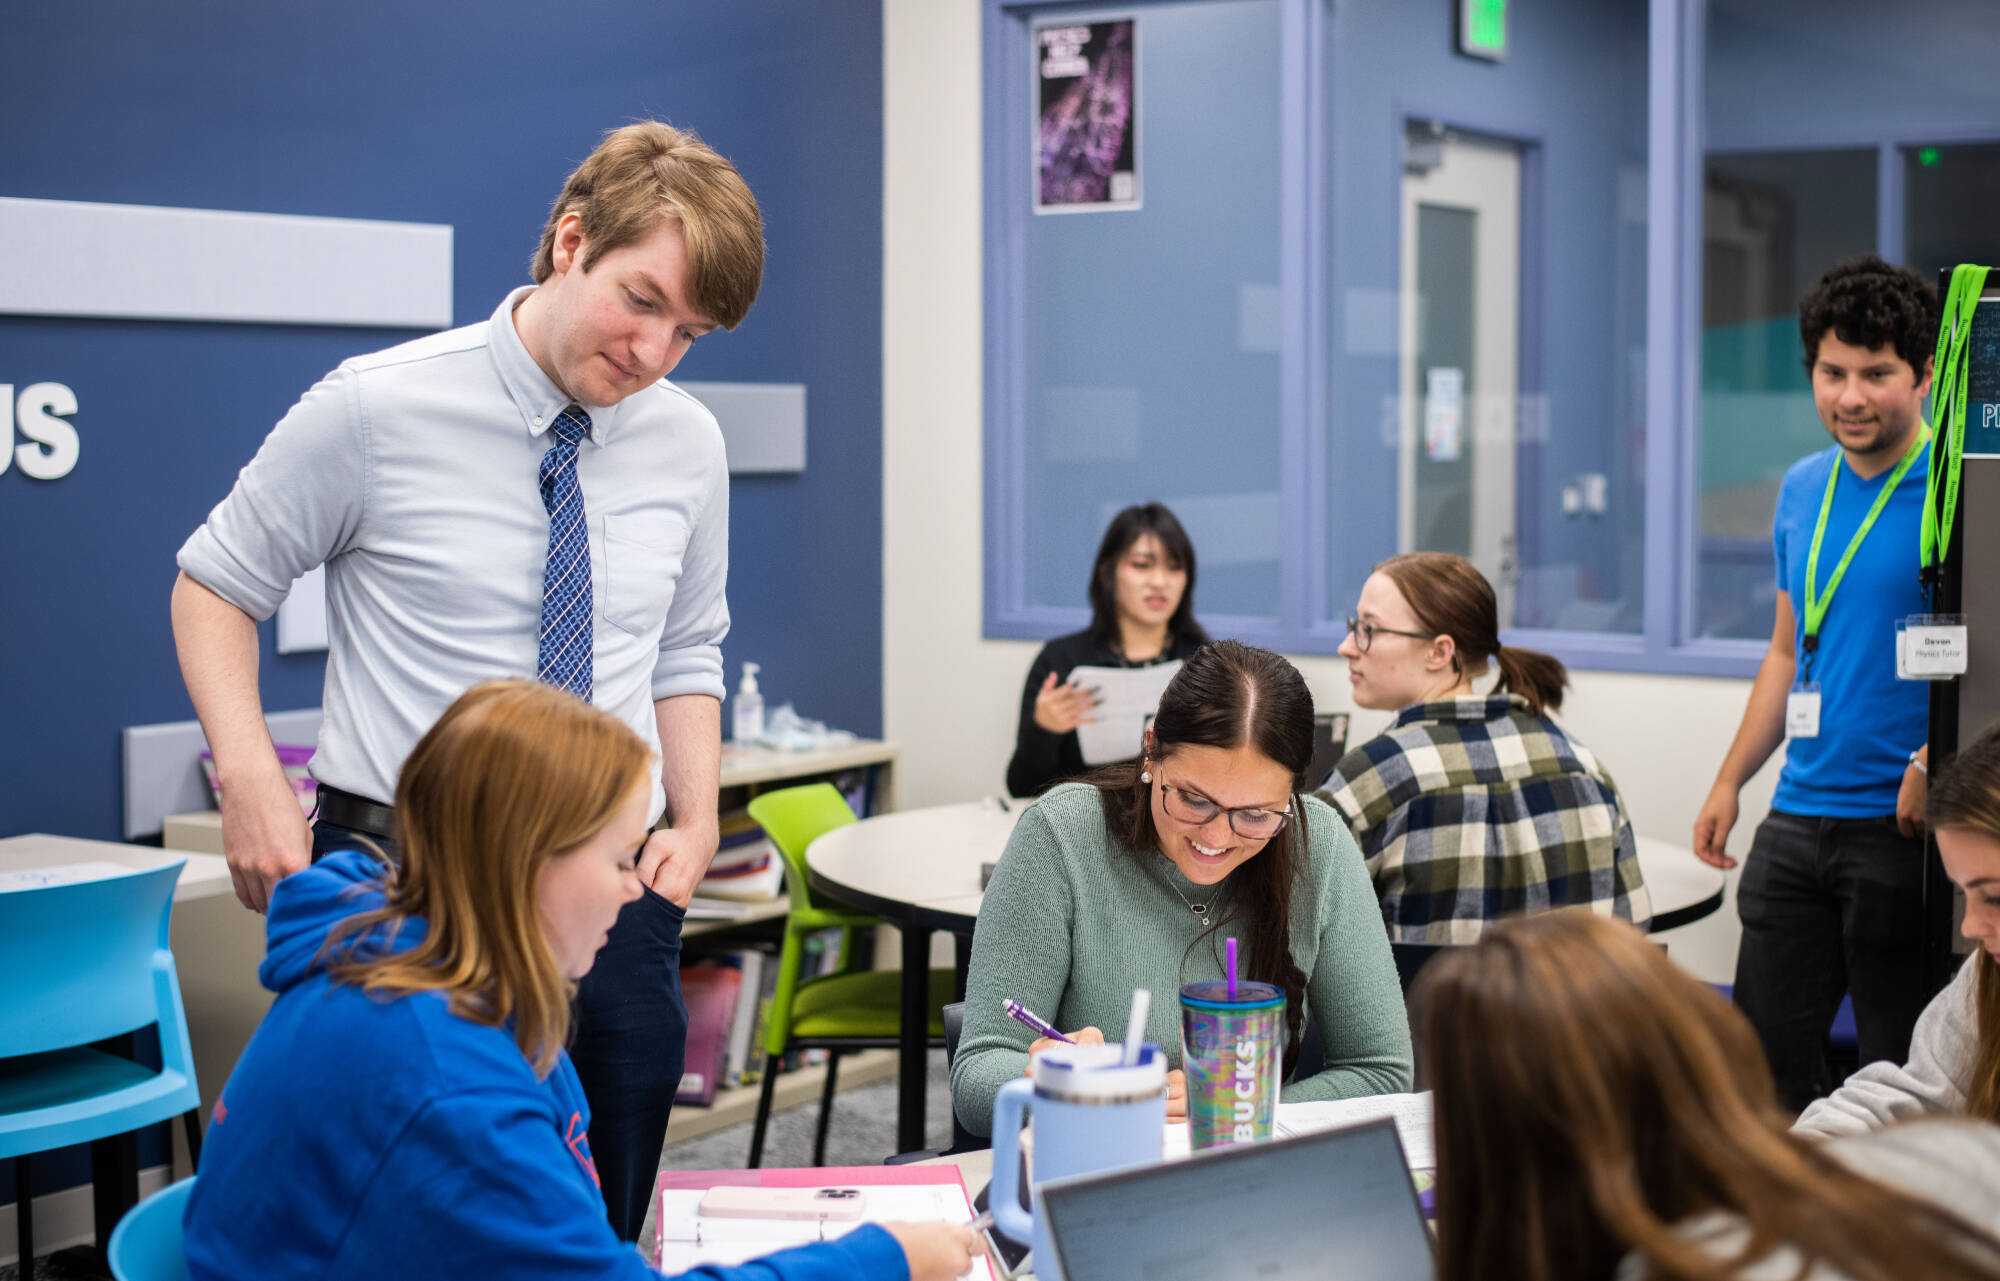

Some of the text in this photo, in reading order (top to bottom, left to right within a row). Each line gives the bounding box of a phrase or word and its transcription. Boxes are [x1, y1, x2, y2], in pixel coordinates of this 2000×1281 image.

[1982, 403, 2000, 428] P
[1915, 649, 1960, 658] Physics Tutor
